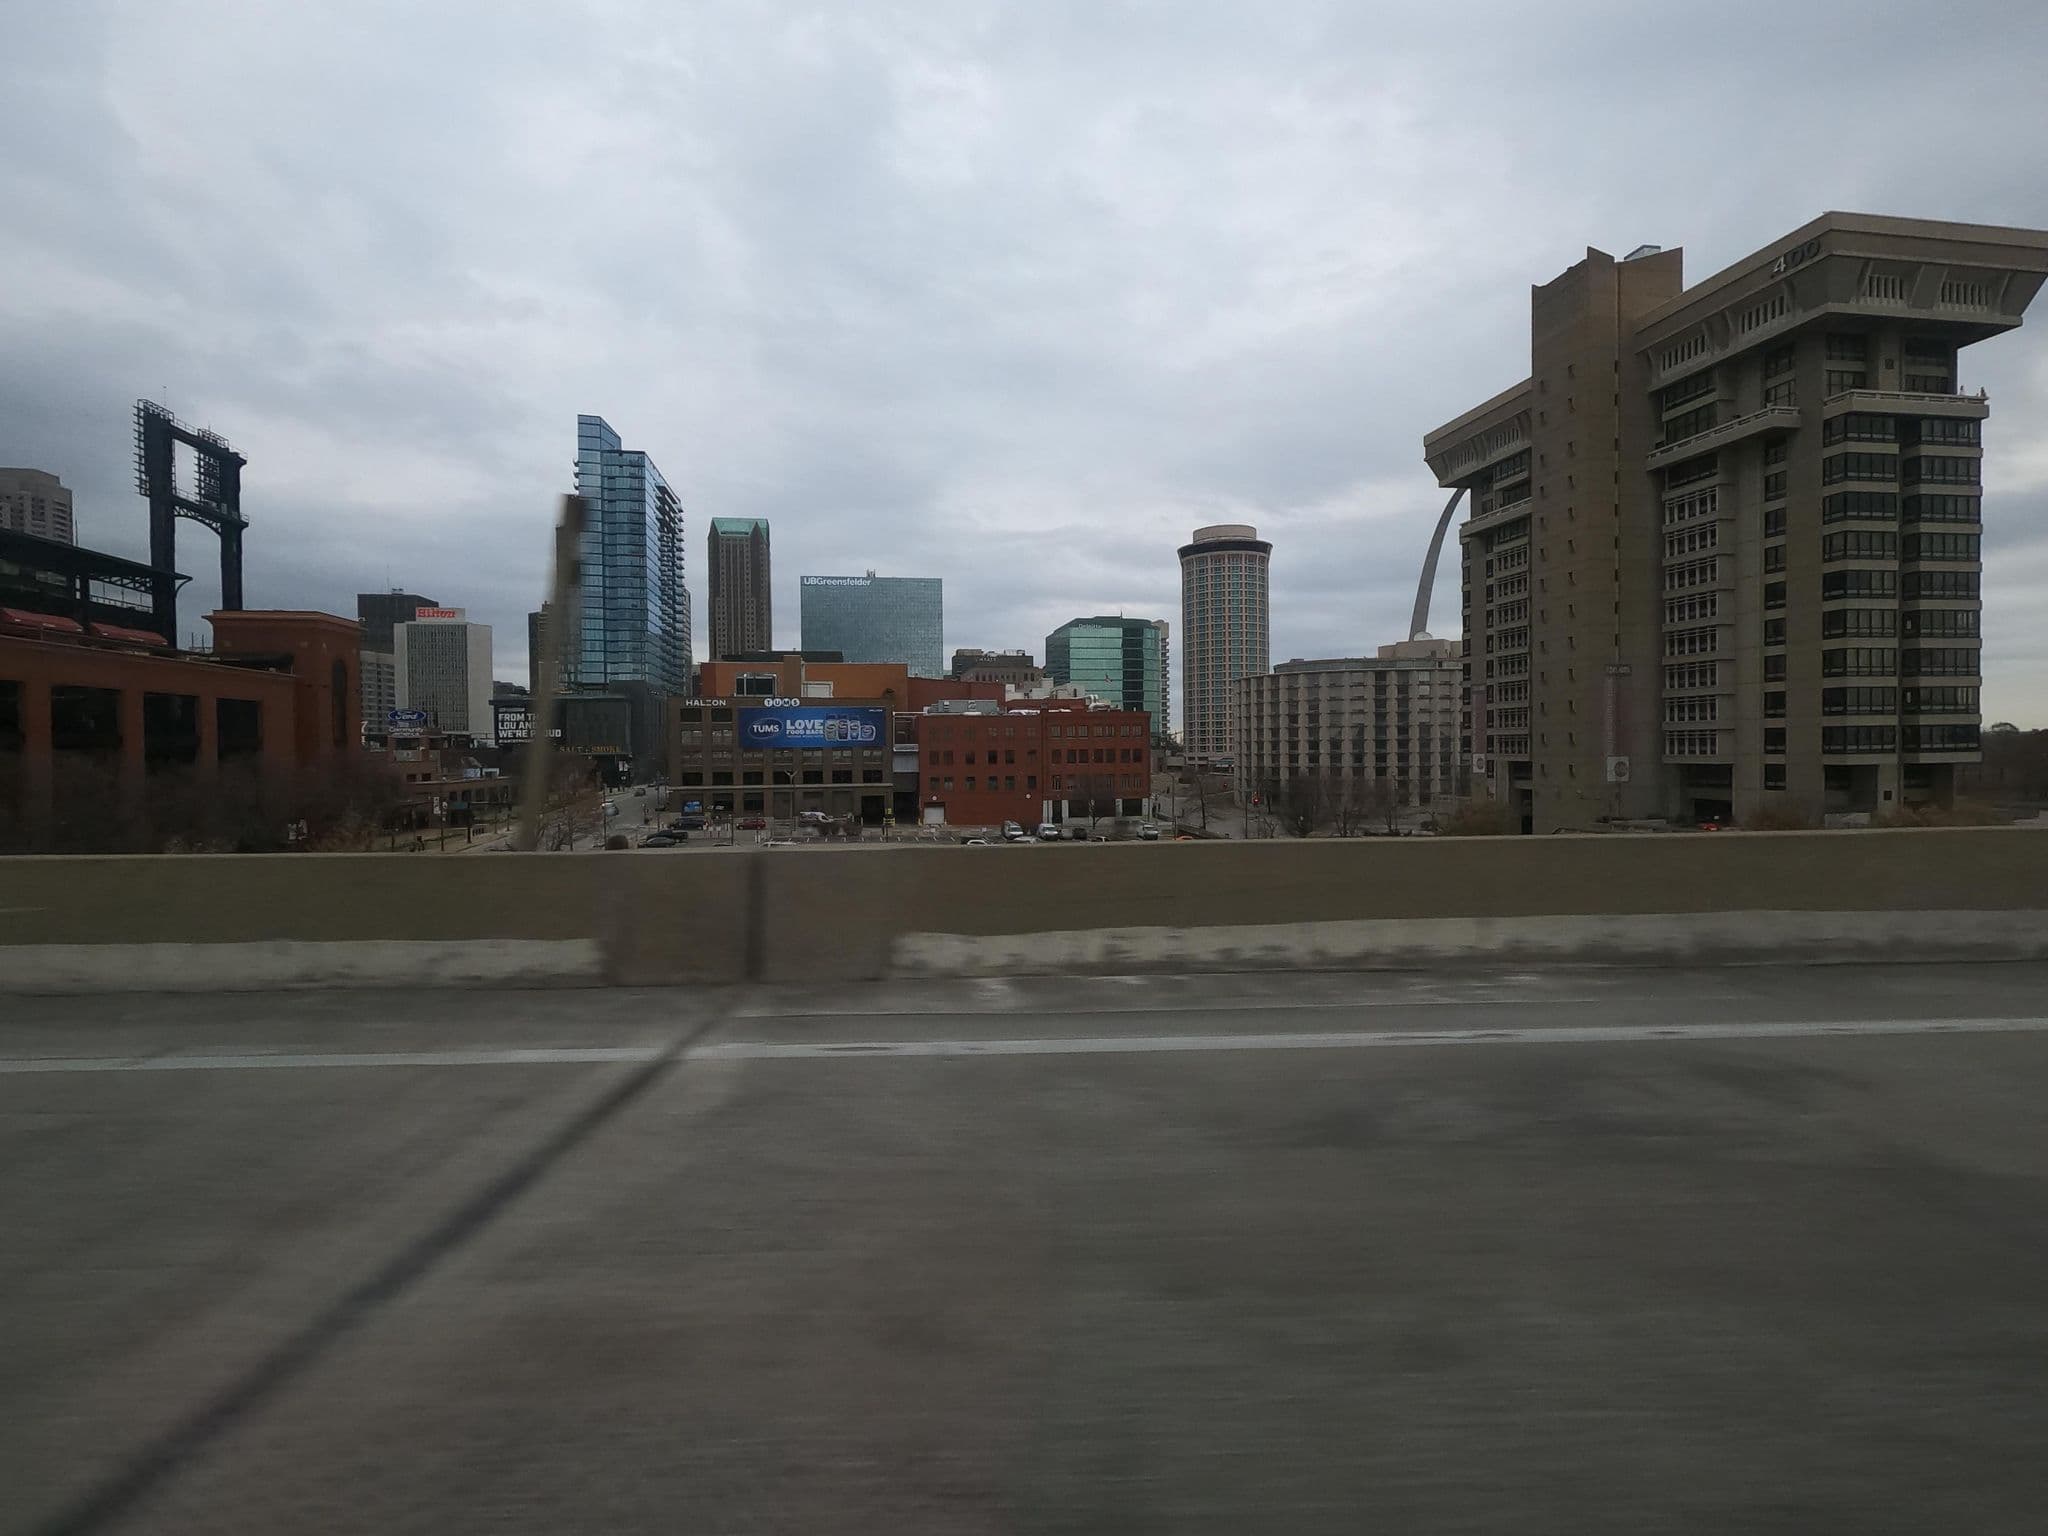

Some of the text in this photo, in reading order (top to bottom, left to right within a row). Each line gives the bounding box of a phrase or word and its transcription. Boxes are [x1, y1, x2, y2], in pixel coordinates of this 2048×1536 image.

[1773, 238, 1821, 273] 400
[804, 576, 871, 586] UBGreensfelder
[417, 608, 456, 618] Hilton
[764, 697, 800, 708] TUMS
[498, 713, 525, 721] FROM
[498, 721, 517, 730] LOU
[752, 724, 780, 733] TUMS
[786, 719, 824, 730] LOVE
[498, 729, 528, 738] WE'RE
